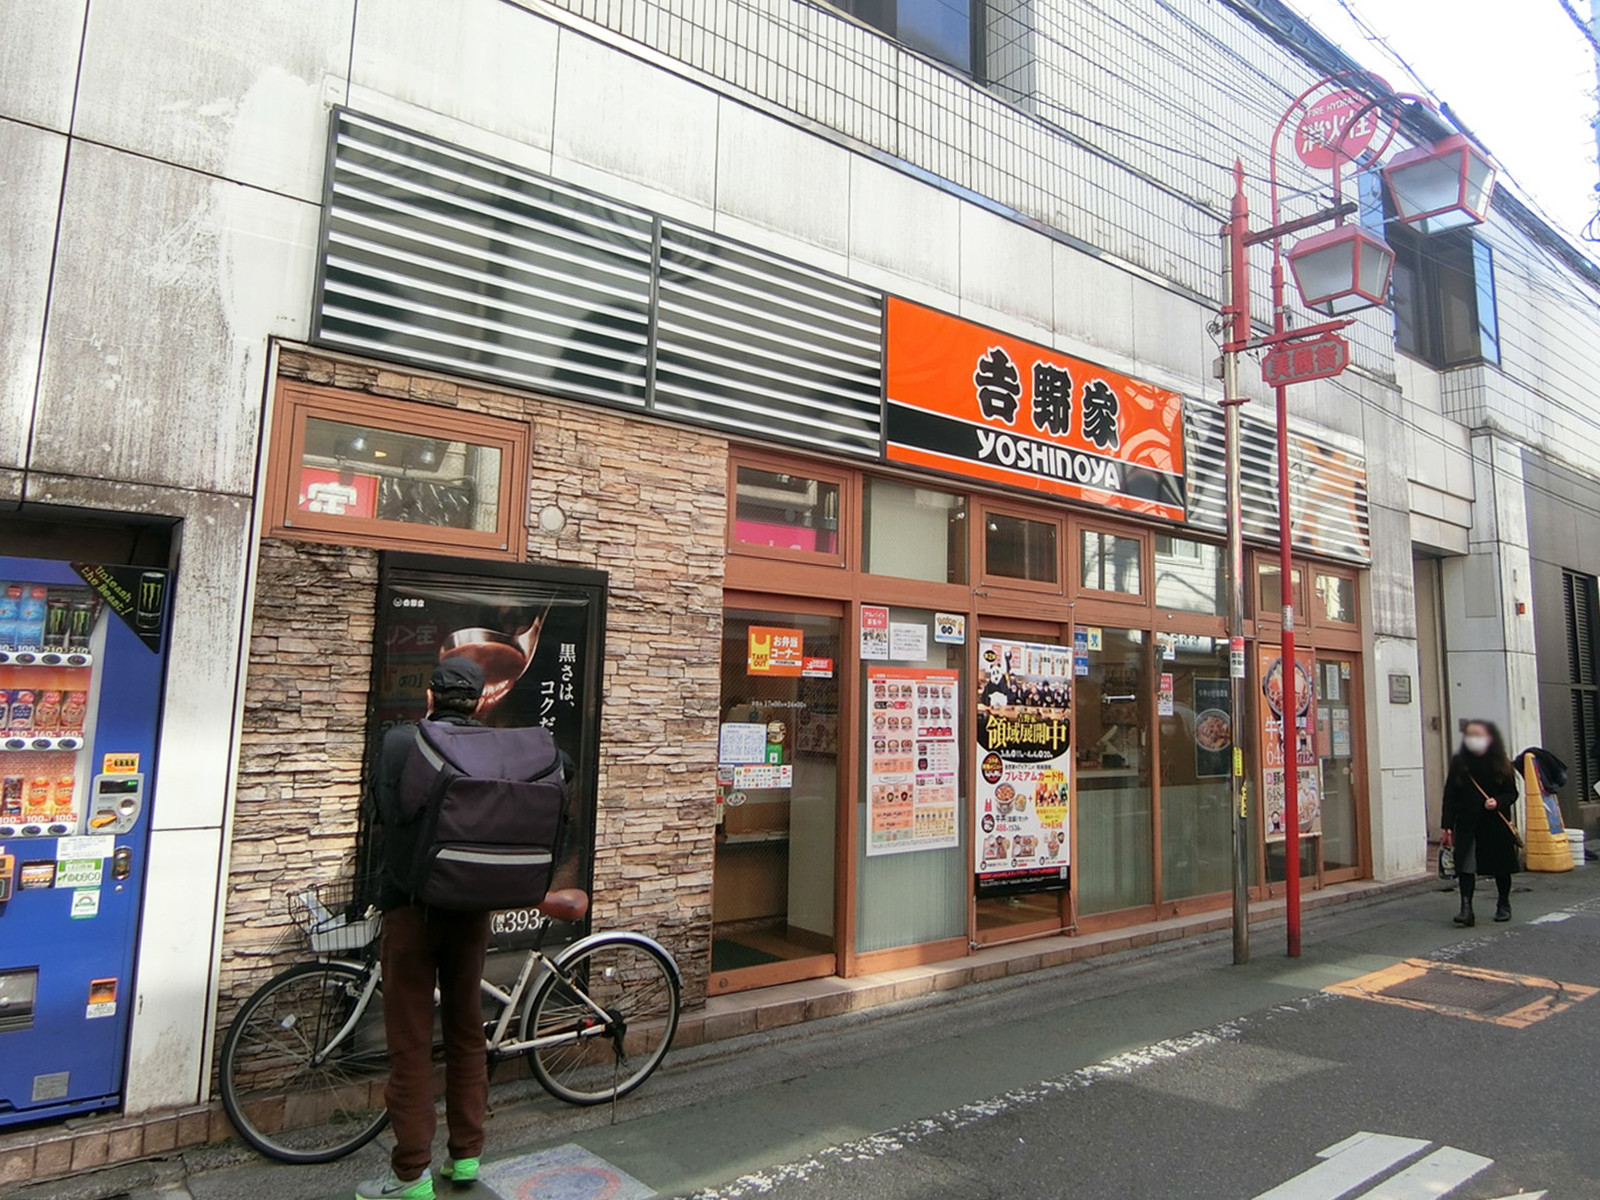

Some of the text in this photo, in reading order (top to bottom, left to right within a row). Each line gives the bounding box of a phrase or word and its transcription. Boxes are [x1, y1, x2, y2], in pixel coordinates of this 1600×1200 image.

[973, 346, 1121, 450] 吉野家
[976, 429, 1121, 491] YOSHINOYA
[94, 565, 132, 602] Unleash
[81, 566, 135, 616] the Beast!
[941, 625, 954, 635] GO
[773, 635, 799, 649] お弁当
[752, 653, 769, 661] TAKE
[770, 648, 801, 660] コーナー
[753, 660, 768, 668] OUT
